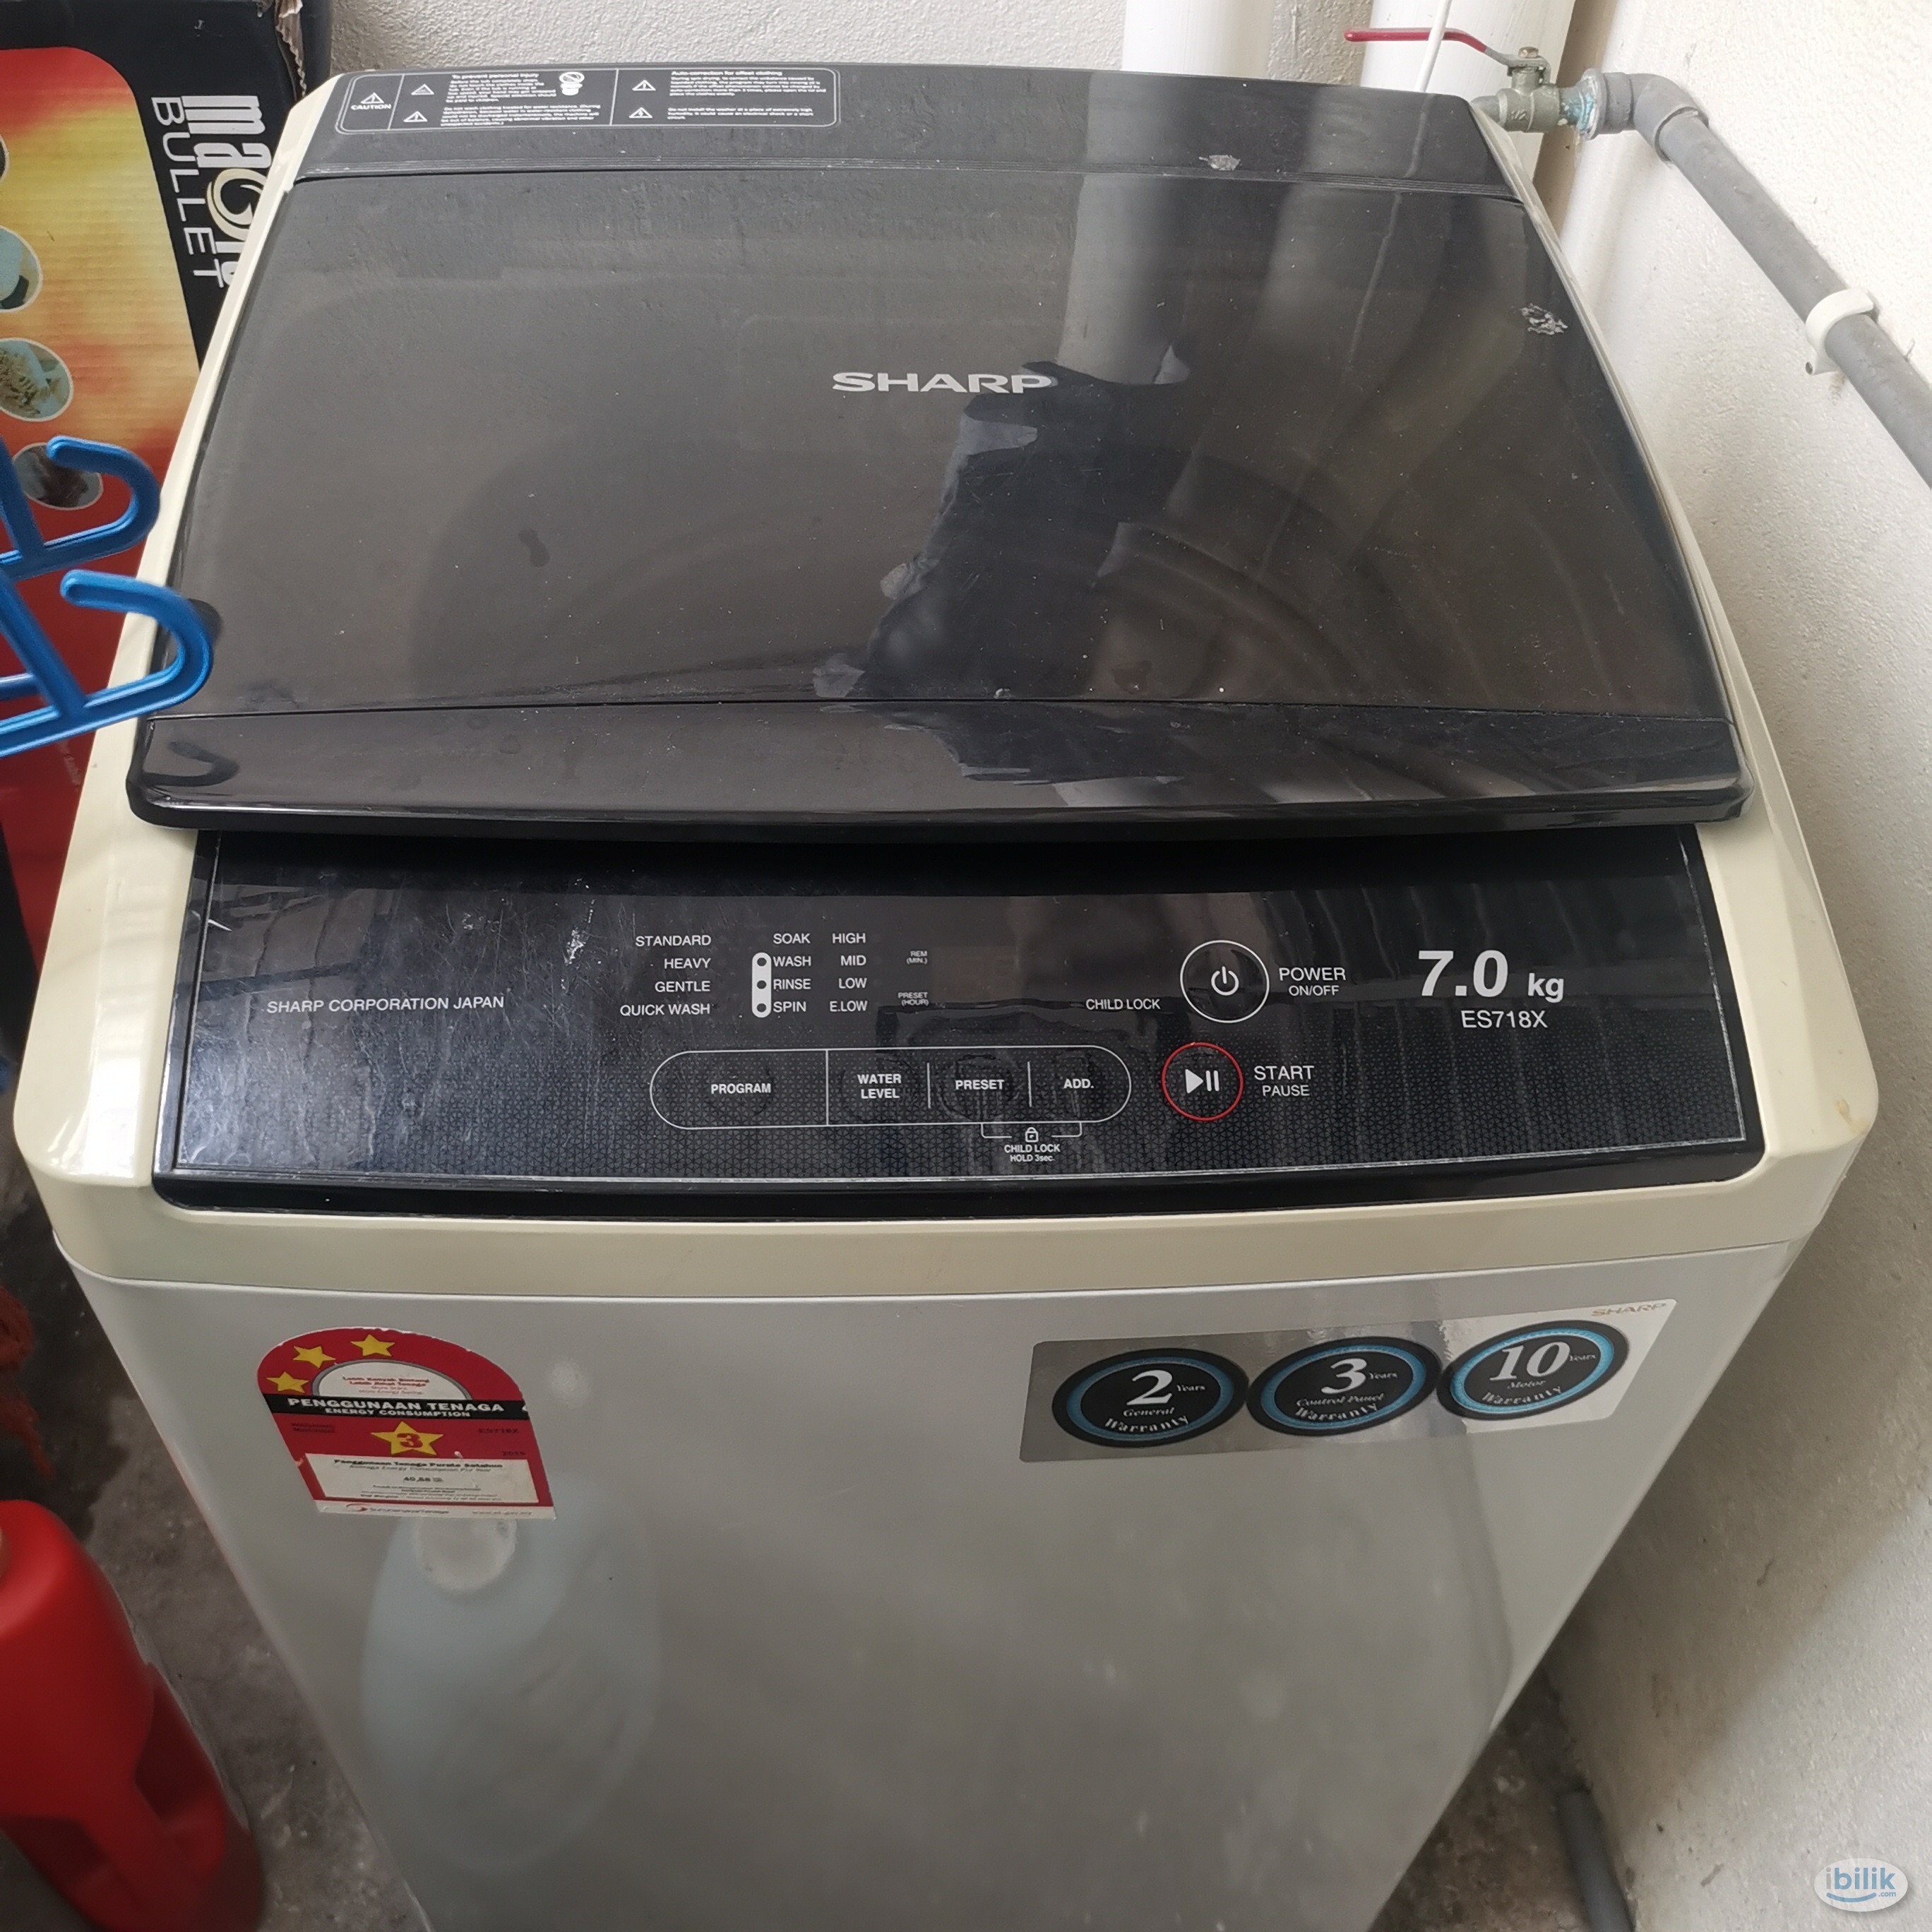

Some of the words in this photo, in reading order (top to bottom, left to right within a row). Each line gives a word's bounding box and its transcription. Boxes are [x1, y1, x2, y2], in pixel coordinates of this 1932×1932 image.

[151, 97, 224, 288] BULLET
[832, 371, 1053, 394] SHARP
[636, 935, 712, 947] STANDARD
[773, 932, 811, 945] SOAK
[832, 932, 866, 945] HIGH
[664, 958, 712, 969] HEAVY
[773, 955, 812, 967] WASH
[840, 954, 867, 966] MID
[1279, 967, 1347, 982] POWER
[1418, 949, 1508, 998] 7.0
[1527, 972, 1564, 1003] kg
[655, 980, 711, 993] GENTLE
[773, 978, 812, 990] RINSE
[838, 977, 868, 989] LOW
[1288, 985, 1340, 996] ON/OFF
[267, 1000, 325, 1013] SHARP
[328, 997, 449, 1012] CORPORATION
[453, 996, 505, 1009] JAPAN
[619, 1004, 665, 1016] QUICK
[668, 1003, 710, 1015] WASH
[773, 1001, 807, 1013] SPIN
[830, 1000, 869, 1013] E.LOW
[1085, 998, 1123, 1010] CHILD
[1126, 998, 1161, 1010] LOCK
[1461, 1010, 1549, 1029] ES718X
[857, 1073, 902, 1085] WATER
[1253, 1065, 1315, 1081] START
[710, 1083, 772, 1095] PROGRAM
[955, 1079, 1005, 1091] PRESET
[1063, 1078, 1095, 1089] ADD.
[861, 1087, 900, 1099] LEVEL
[1262, 1085, 1310, 1097] PAUSE
[1004, 1144, 1033, 1154] CHILD
[1034, 1144, 1061, 1153] LOCK
[1010, 1154, 1034, 1162] HOLD
[1591, 1302, 1667, 1317] SHARP
[1489, 1341, 1571, 1382] 10
[1568, 1354, 1597, 1362] Years
[1321, 1357, 1368, 1395] 3
[1126, 1369, 1173, 1406] 2
[1176, 1384, 1206, 1393] Years
[1507, 1379, 1546, 1390] Motor
[1296, 1395, 1346, 1407] Control
[1347, 1393, 1385, 1404] Panel
[1481, 1385, 1562, 1405] Warranty
[287, 1397, 422, 1410] PENGGUNAAN
[426, 1401, 505, 1412] TENAGA
[378, 1409, 471, 1418] CONSUMPTION
[1123, 1407, 1176, 1417] General
[1295, 1402, 1378, 1421] Warranty
[1104, 1414, 1190, 1433] Warranty
[396, 1432, 424, 1448] 3
